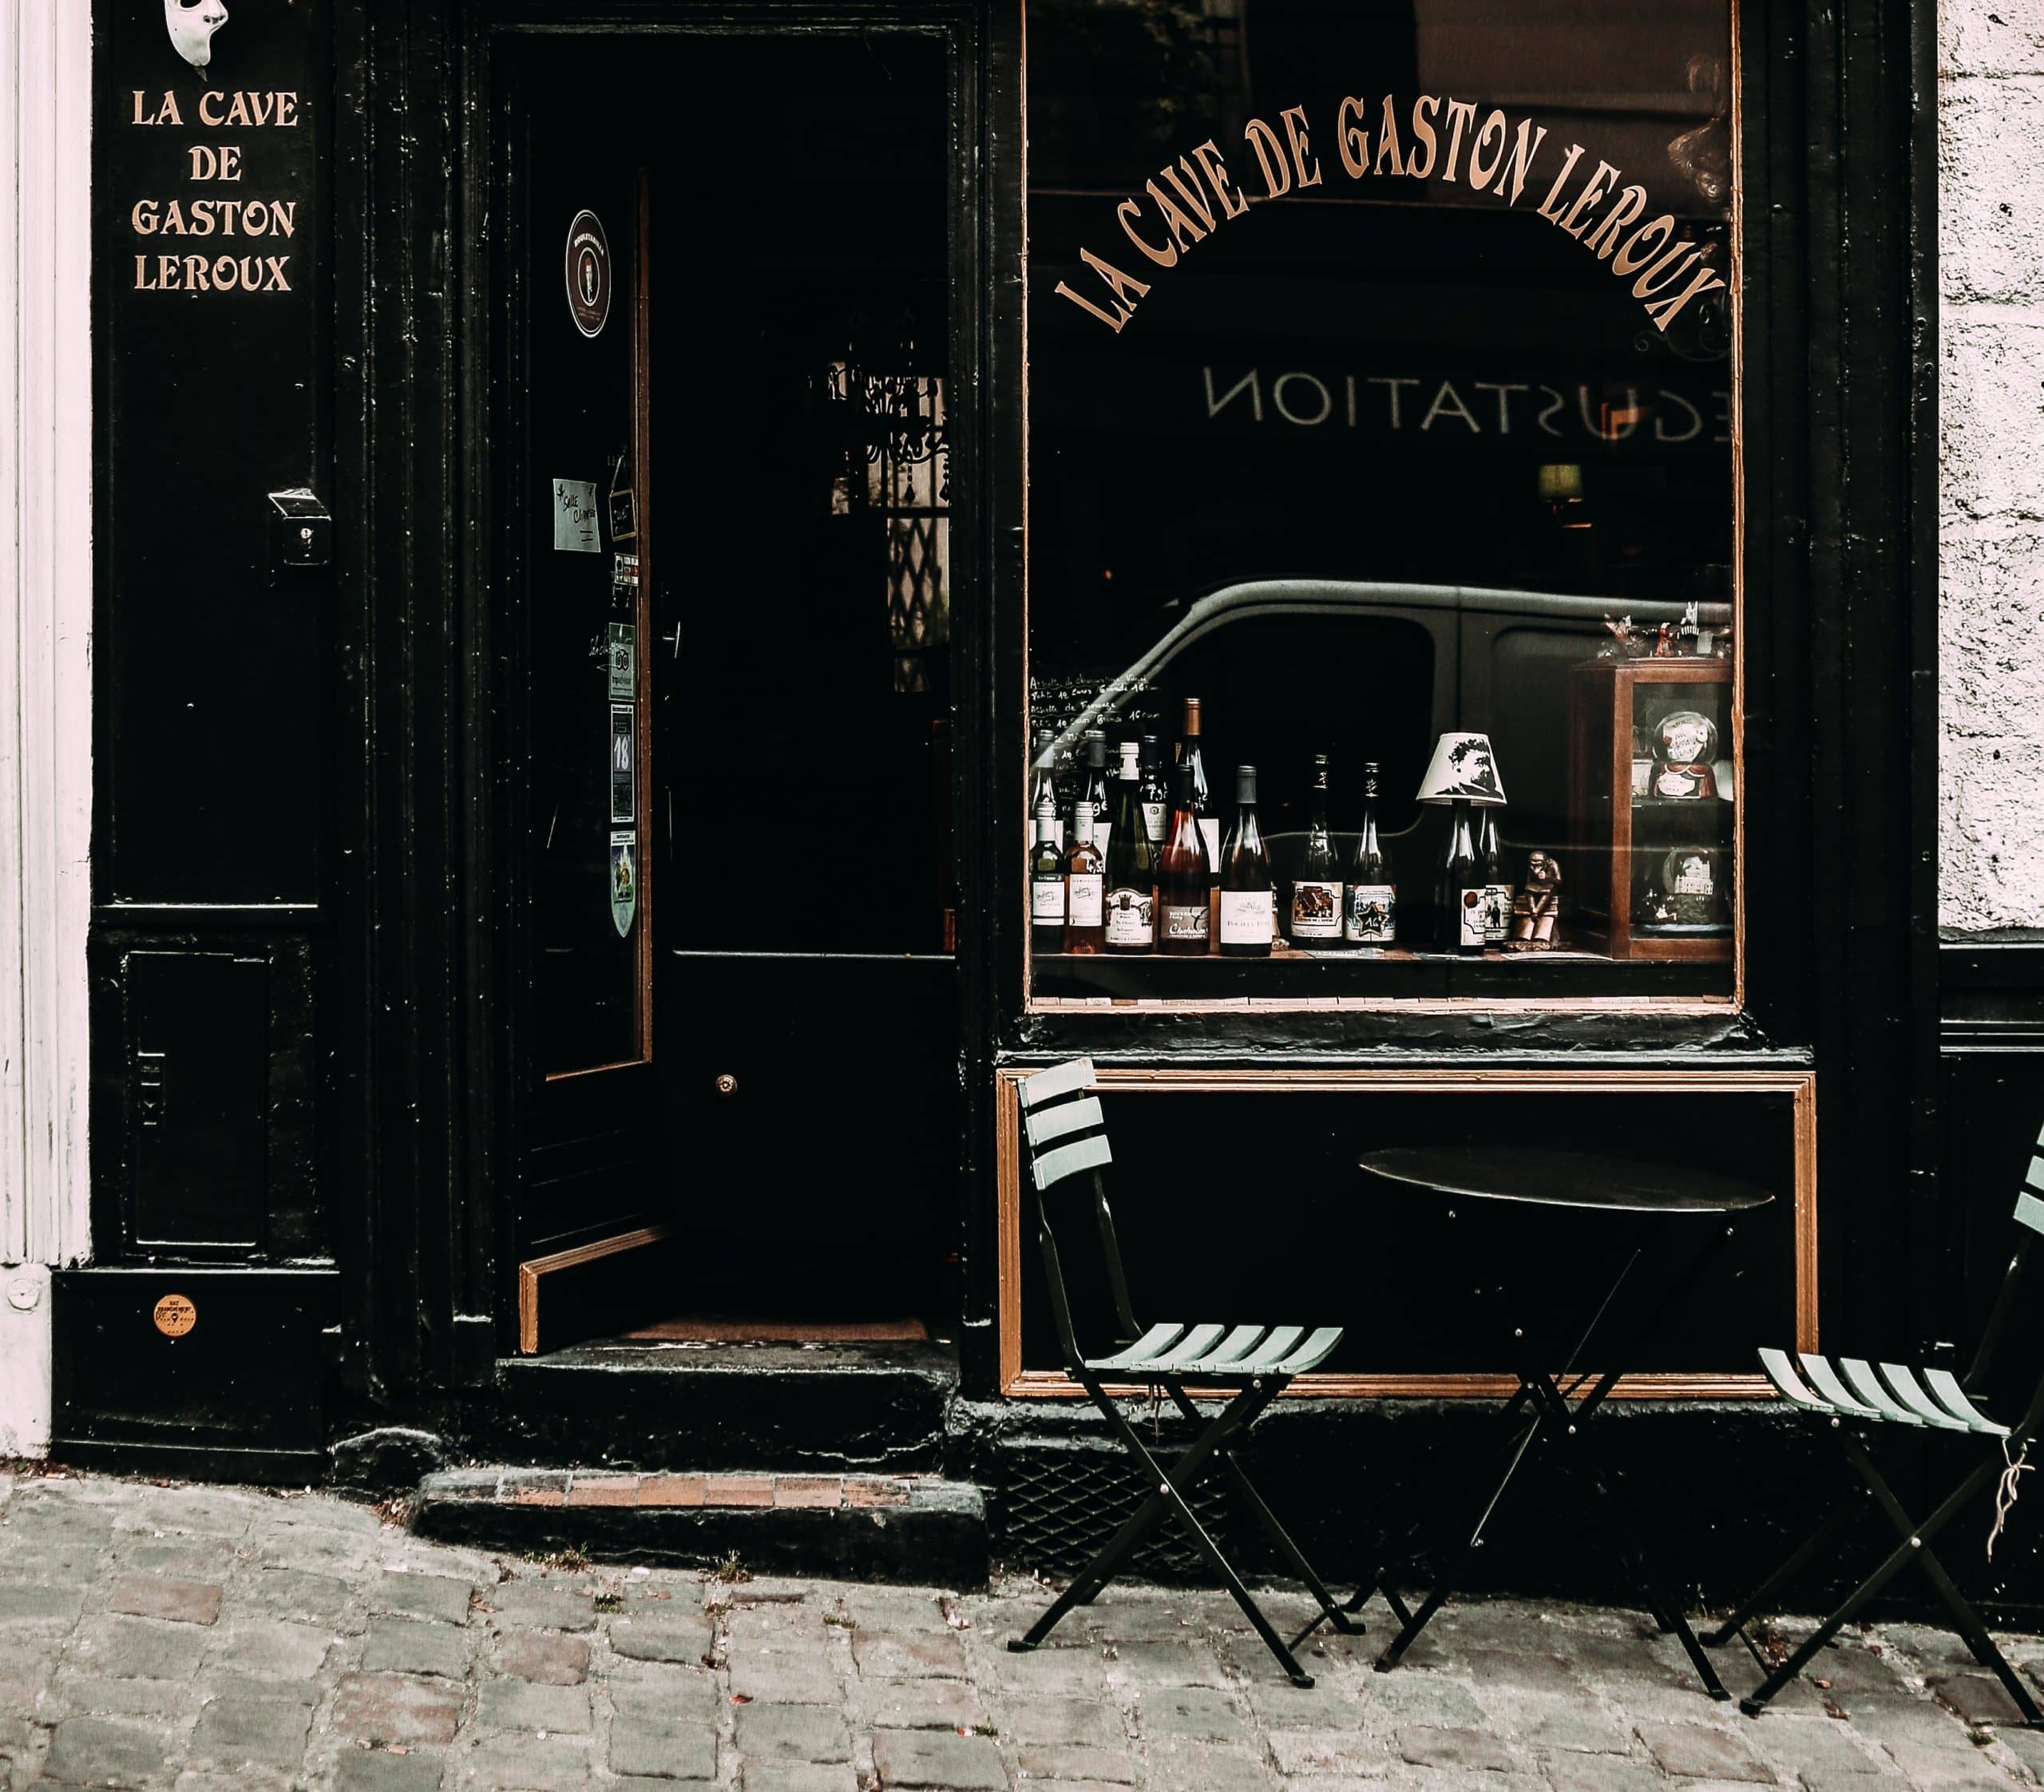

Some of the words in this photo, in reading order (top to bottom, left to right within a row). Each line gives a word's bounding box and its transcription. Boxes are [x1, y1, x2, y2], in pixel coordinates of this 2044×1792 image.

[132, 90, 184, 126] LA
[198, 90, 299, 127] CAVE
[187, 145, 243, 181] DE
[131, 200, 296, 239] GASTON
[1054, 247, 1151, 334] LA
[1116, 138, 1251, 268] CAVE
[1244, 104, 1323, 200] DE
[1337, 93, 1547, 206] GASTON
[1536, 143, 1726, 334] LEROUX
[133, 255, 292, 291] LEROUX
